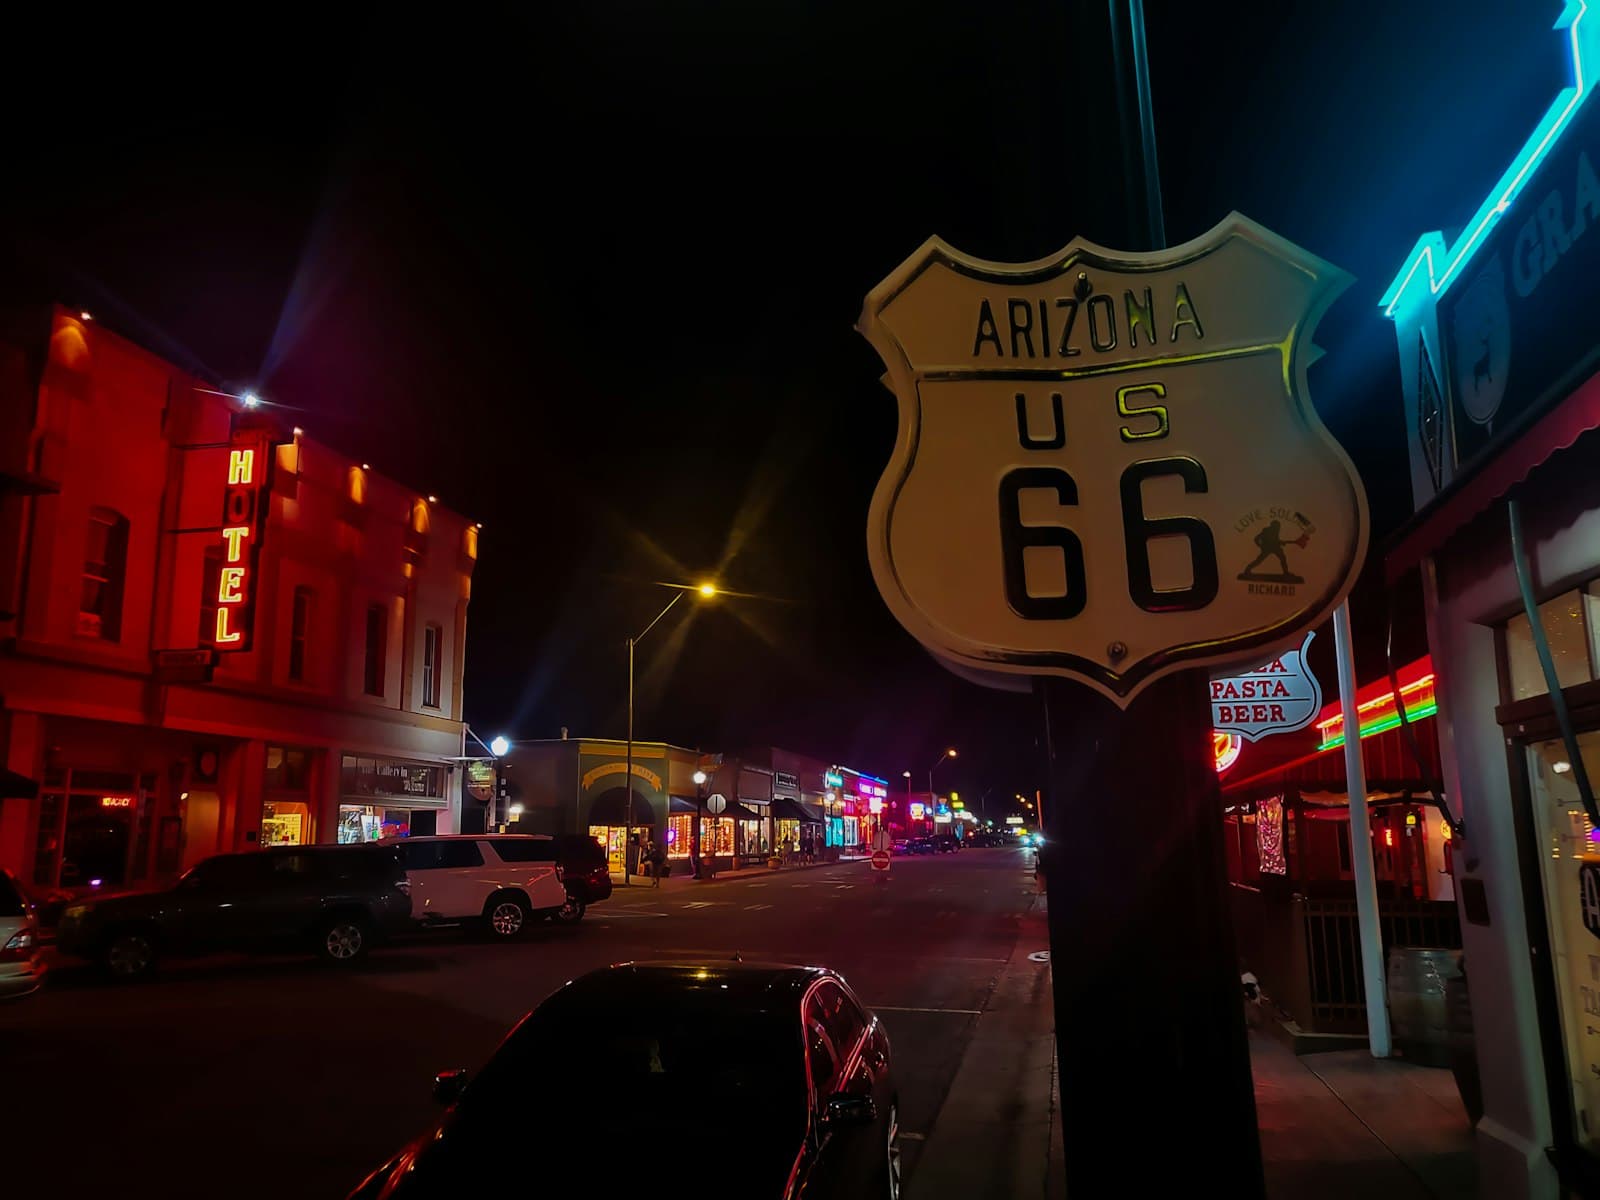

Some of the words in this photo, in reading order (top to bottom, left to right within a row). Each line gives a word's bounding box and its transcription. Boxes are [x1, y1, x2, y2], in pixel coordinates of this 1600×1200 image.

[972, 282, 1204, 358] ARIZONA
[215, 449, 255, 644] HOTEL
[998, 455, 1219, 621] 66
[1248, 584, 1297, 597] RICHARD
[1211, 680, 1290, 699] PASTA
[1219, 704, 1286, 723] BEER
